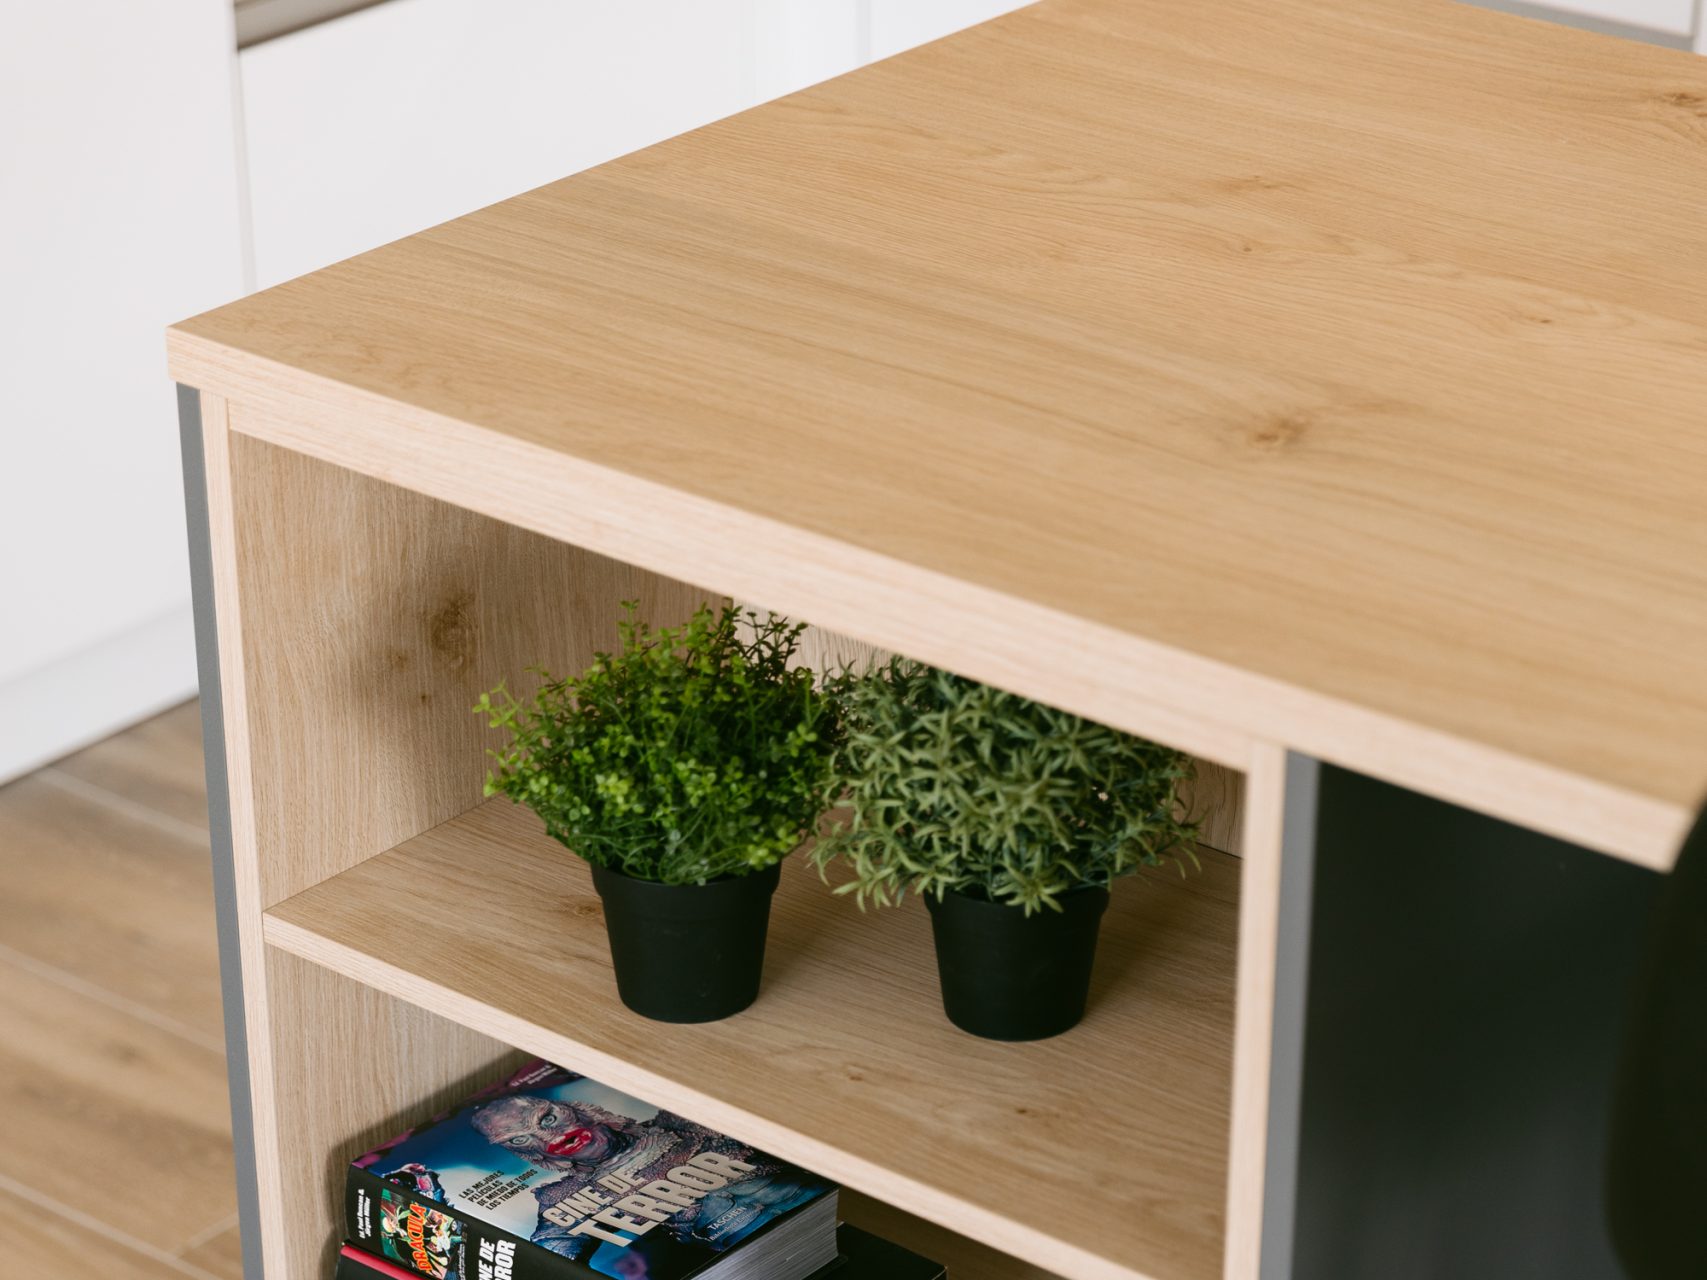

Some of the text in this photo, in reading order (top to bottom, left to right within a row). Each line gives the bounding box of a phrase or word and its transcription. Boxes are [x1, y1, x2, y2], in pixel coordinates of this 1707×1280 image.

[459, 1170, 504, 1199] LAS MEJORES
[477, 1169, 538, 1207] DE MIEDO DE TODOS
[486, 1183, 529, 1211] LOS TIEMPOS
[542, 1166, 647, 1227] CINE DE
[567, 1151, 757, 1248] TERROR
[707, 1206, 748, 1231] TASCHEN
[406, 1202, 432, 1272] DRACULA
[479, 1237, 496, 1263] DE
